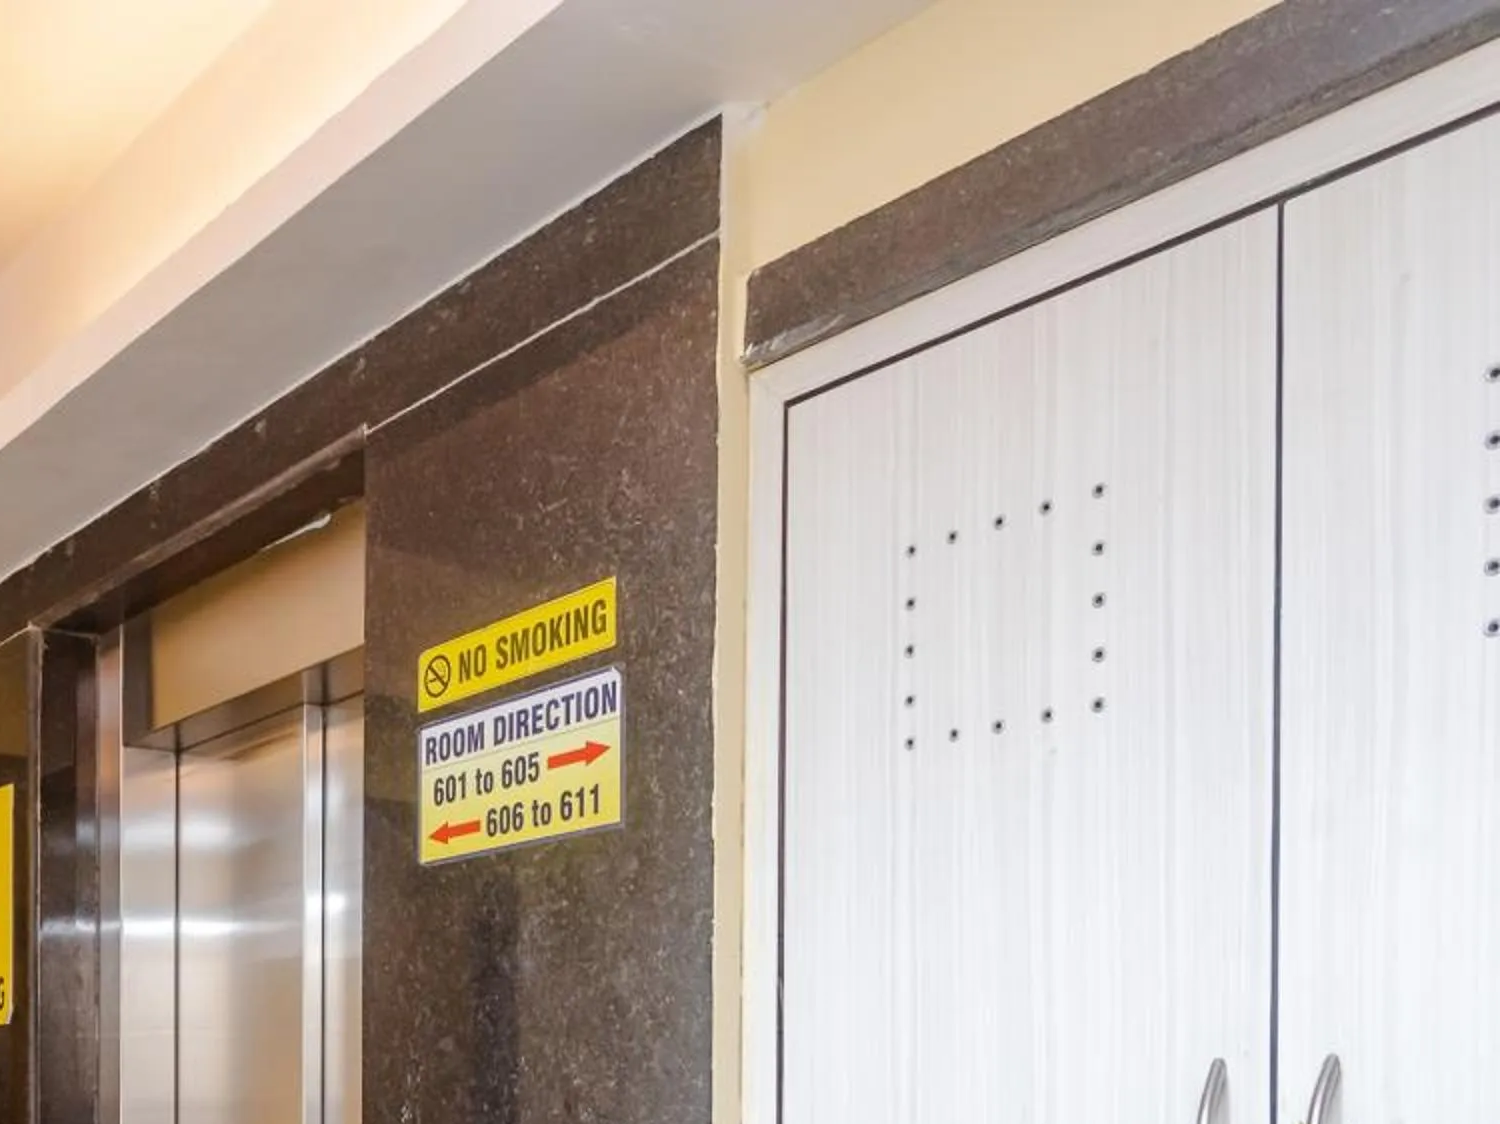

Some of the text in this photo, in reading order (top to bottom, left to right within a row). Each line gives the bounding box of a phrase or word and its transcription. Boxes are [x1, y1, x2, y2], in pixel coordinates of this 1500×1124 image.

[458, 599, 607, 684] NO SMOKING
[425, 681, 617, 766] ROOM DIRECTION
[433, 752, 540, 806] 601 to 605
[486, 783, 601, 837] 606 to 611
